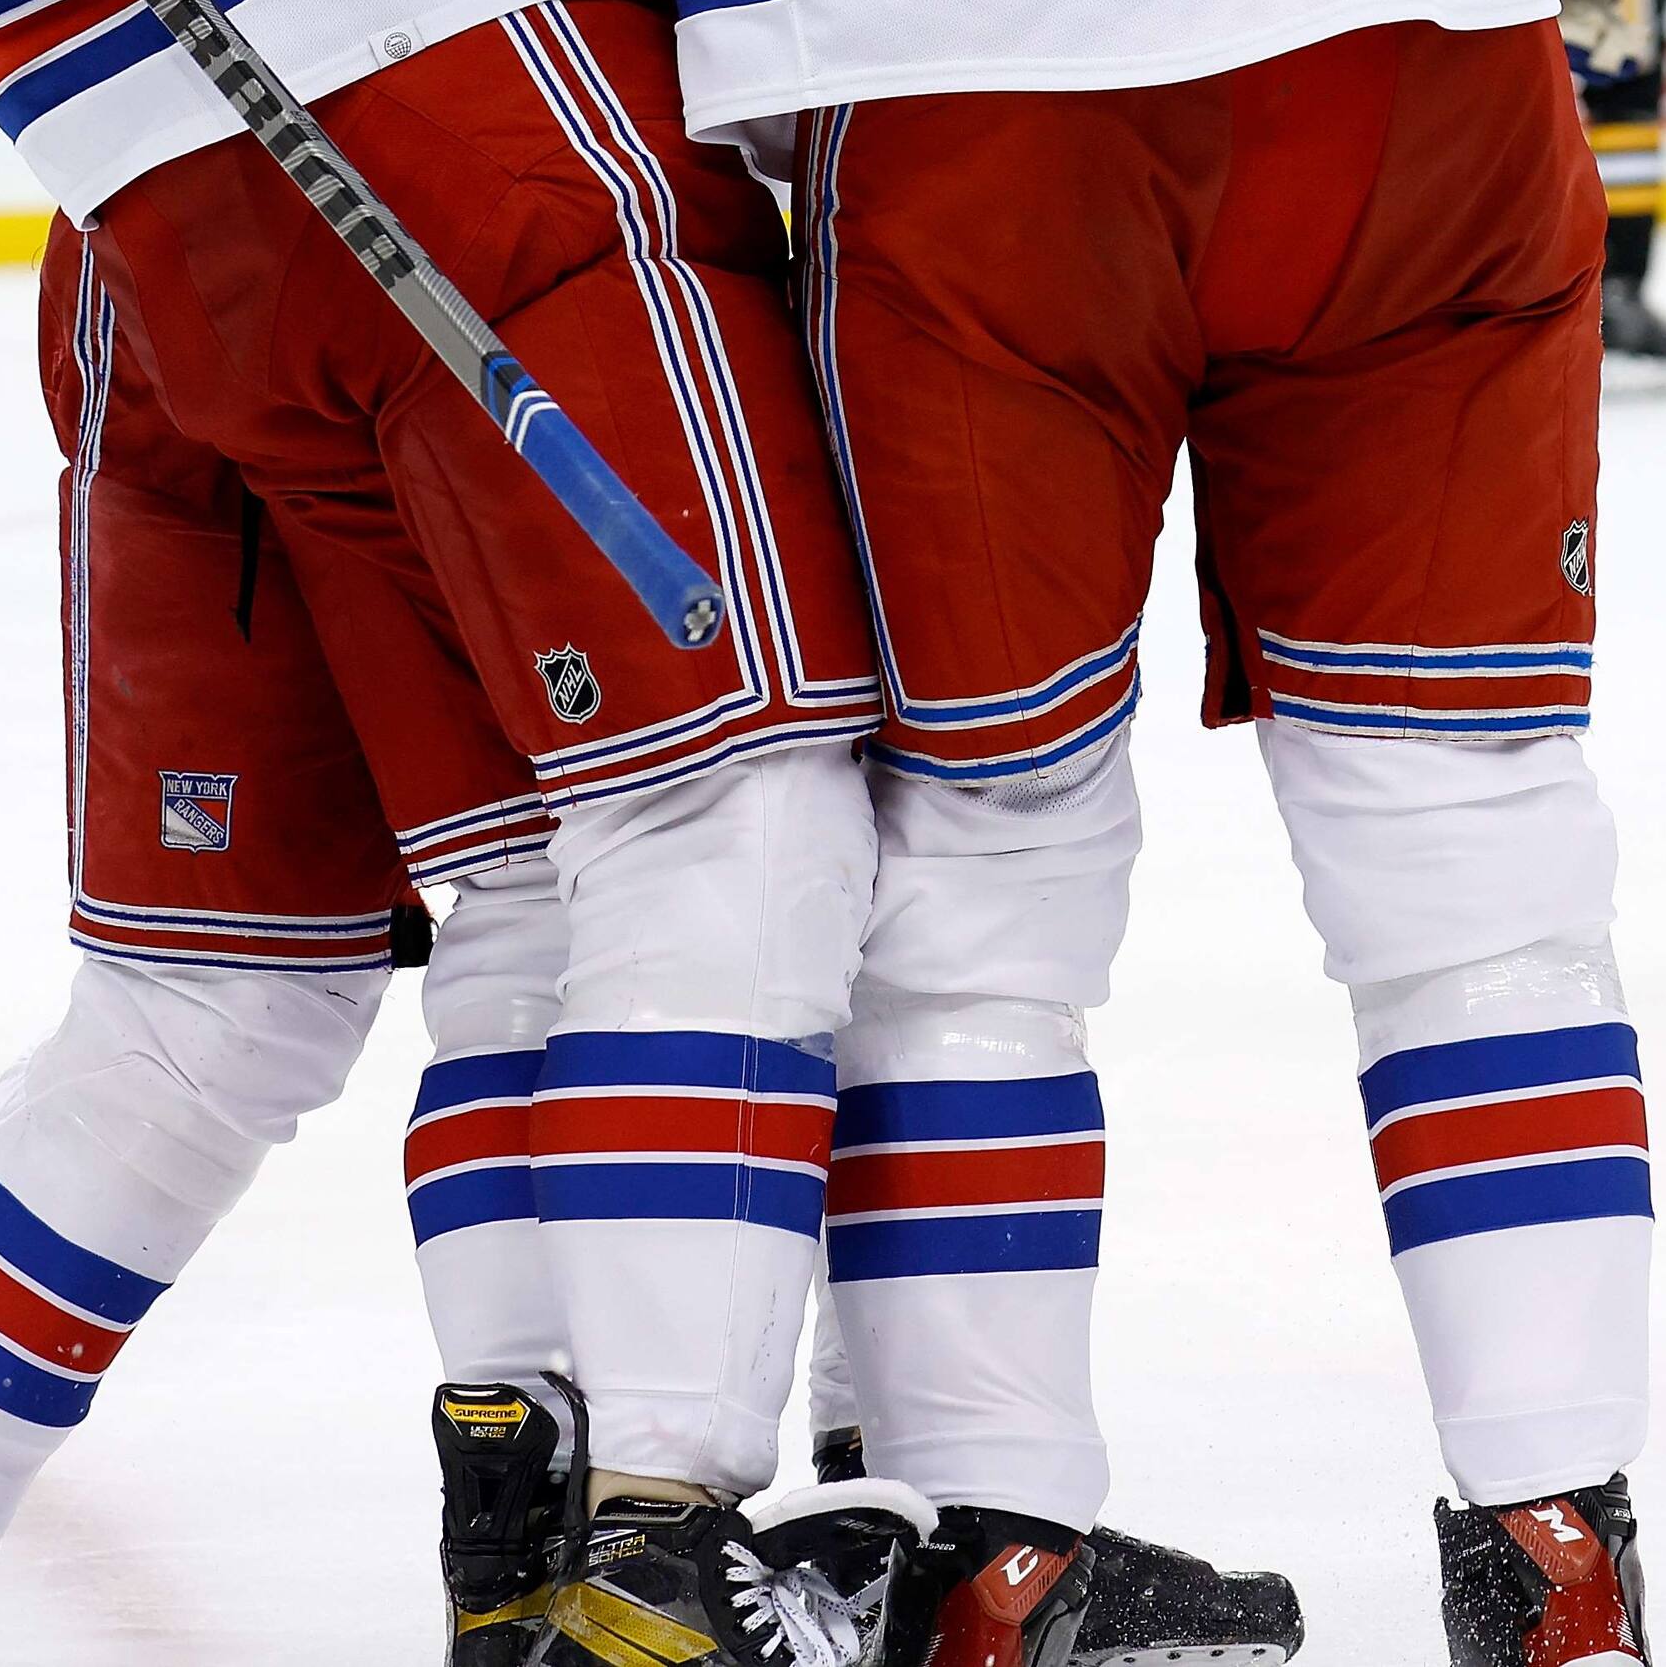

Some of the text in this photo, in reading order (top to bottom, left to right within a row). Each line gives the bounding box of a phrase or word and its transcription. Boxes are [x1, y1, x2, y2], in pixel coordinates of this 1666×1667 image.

[558, 663, 583, 710] NHL
[166, 778, 228, 796] NEW YORK
[173, 798, 224, 845] RANGERS
[589, 1534, 646, 1558] ULTRA
